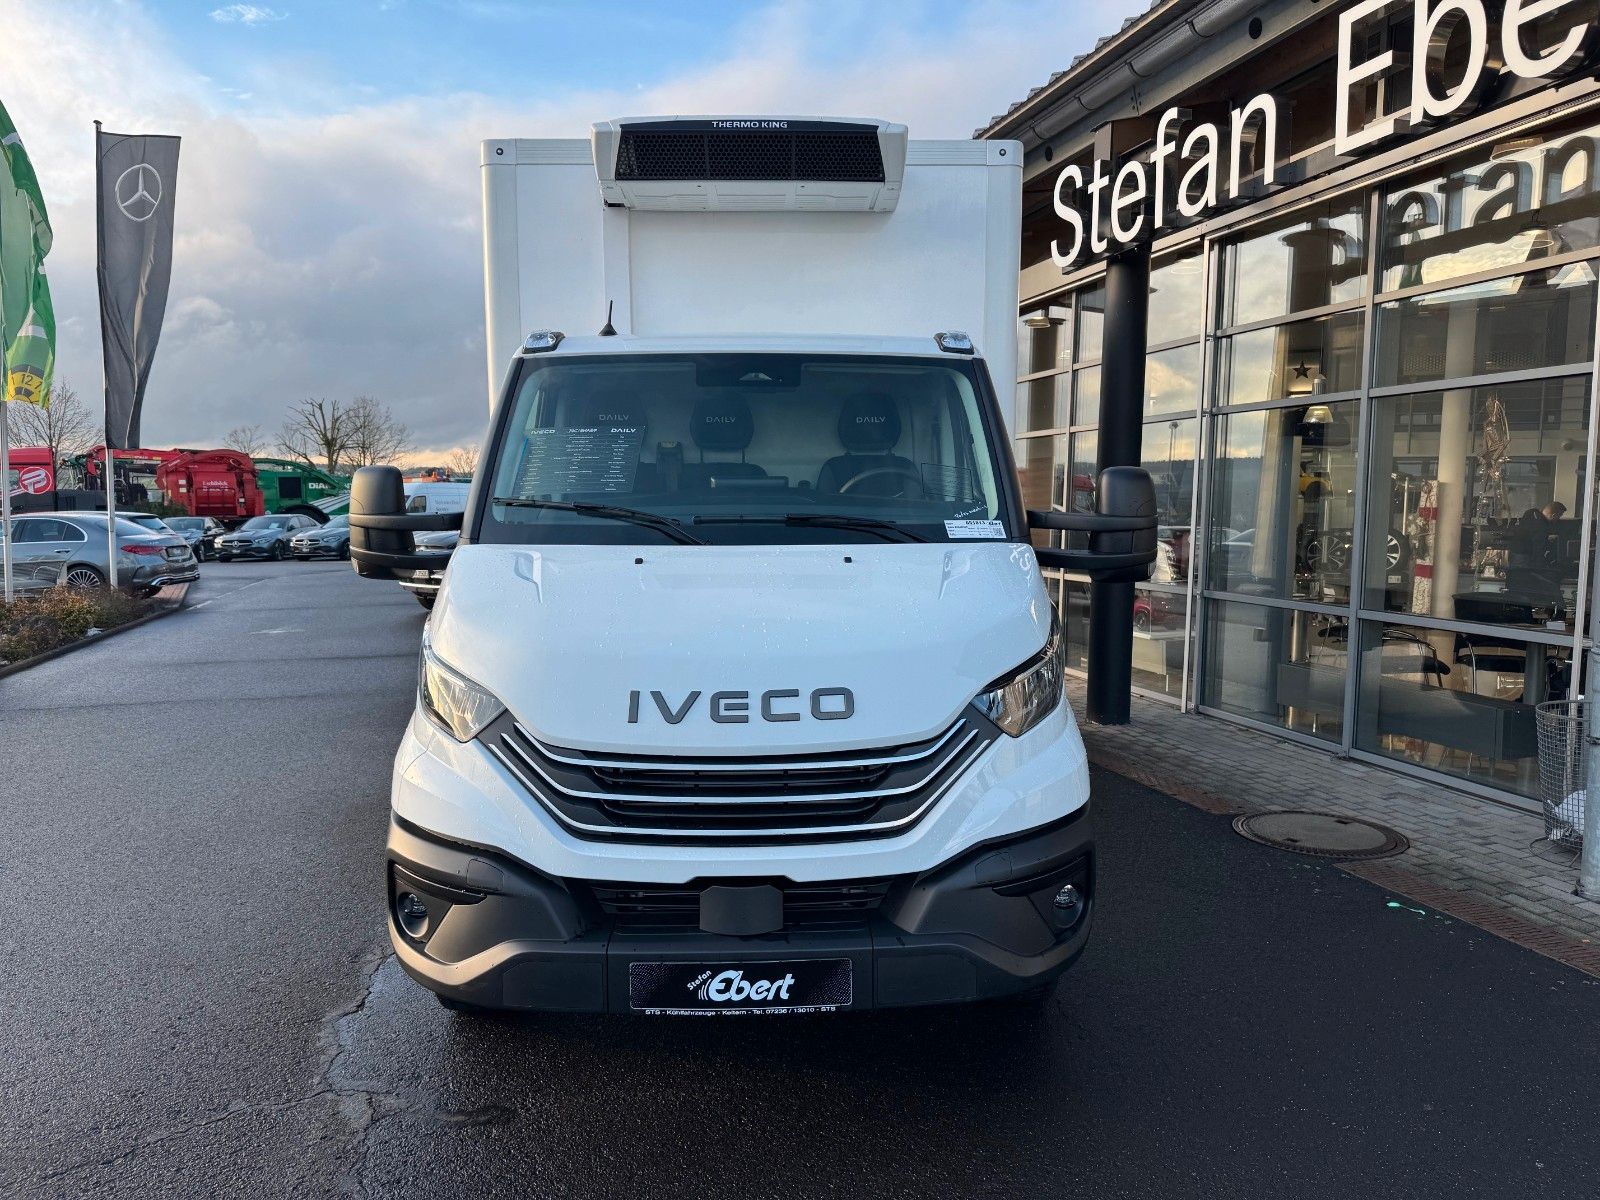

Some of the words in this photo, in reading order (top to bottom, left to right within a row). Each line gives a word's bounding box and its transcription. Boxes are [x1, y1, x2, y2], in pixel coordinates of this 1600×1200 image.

[1050, 93, 1278, 269] Stefan
[628, 687, 855, 725] IVECO
[686, 970, 712, 991] Stefan
[706, 969, 795, 1002] Ebert
